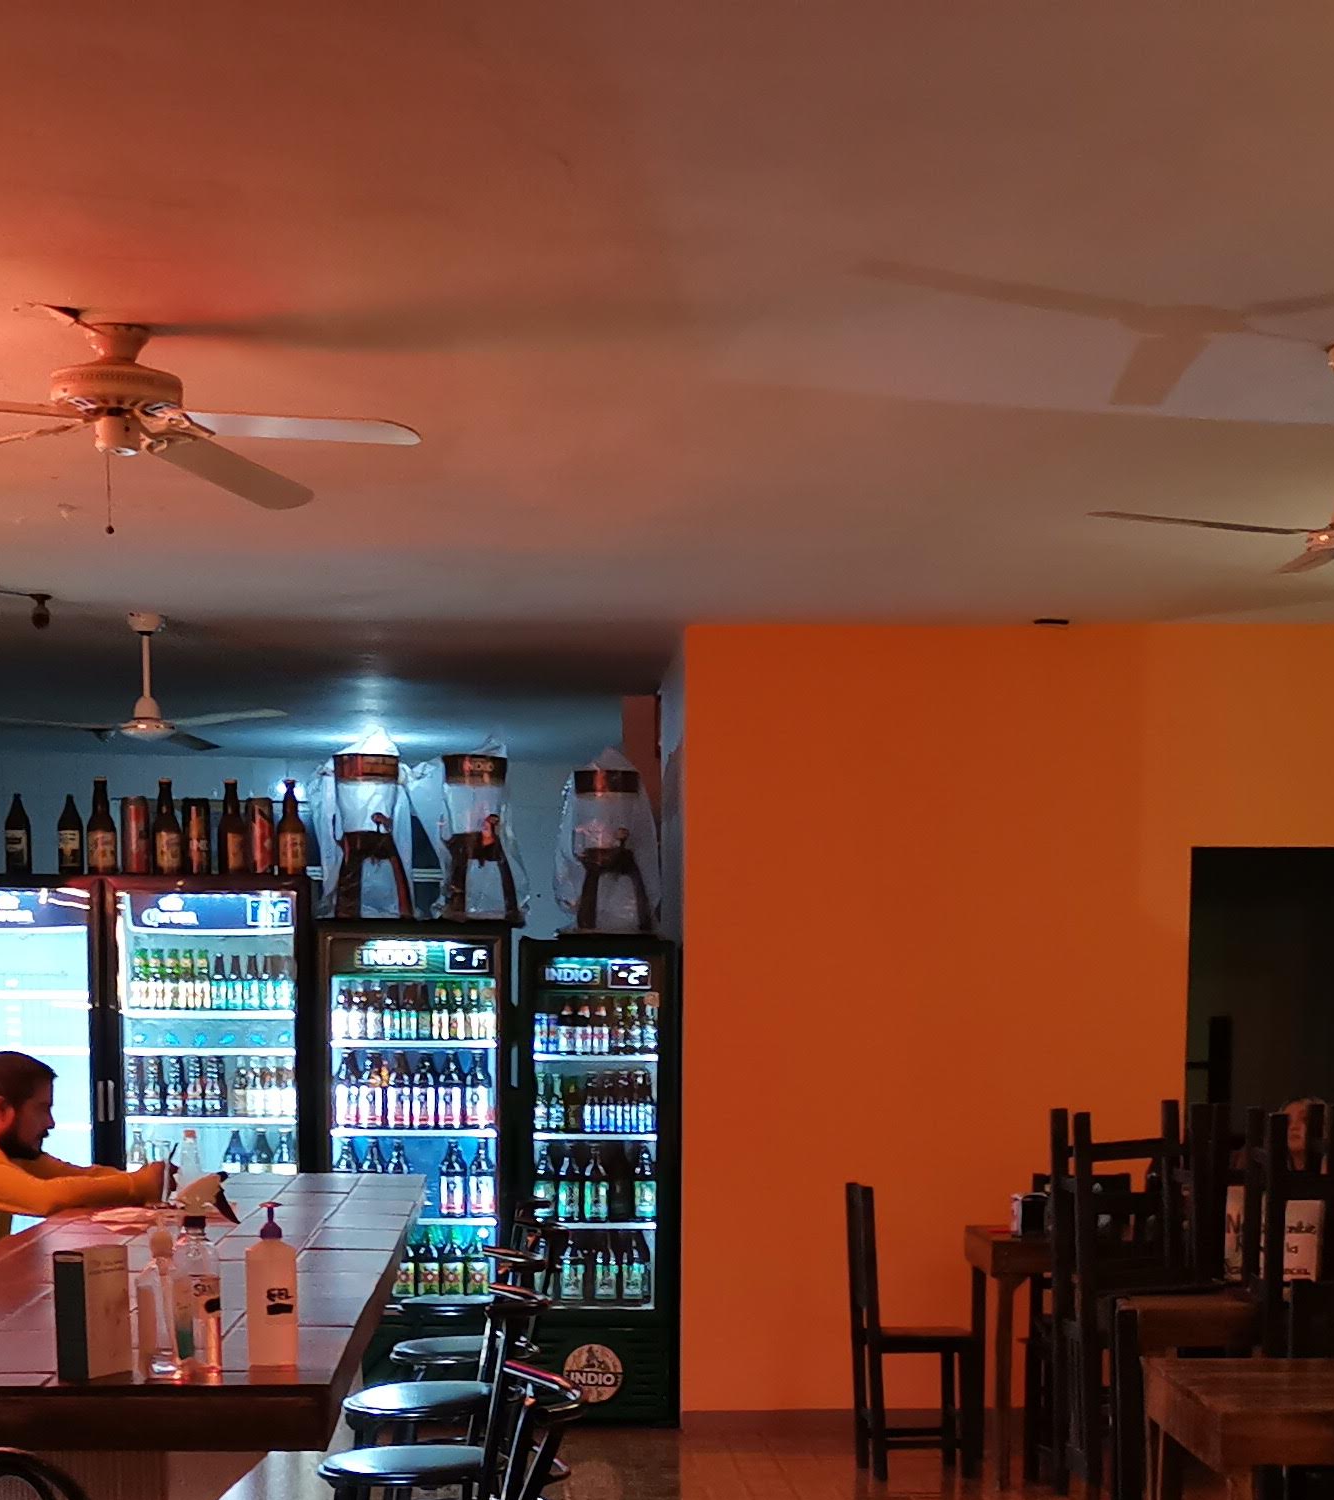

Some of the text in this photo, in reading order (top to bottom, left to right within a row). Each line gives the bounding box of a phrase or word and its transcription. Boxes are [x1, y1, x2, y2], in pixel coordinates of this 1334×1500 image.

[362, 949, 419, 966] INDIO
[545, 966, 593, 982] INDIO
[569, 1371, 616, 1386] INDIO
